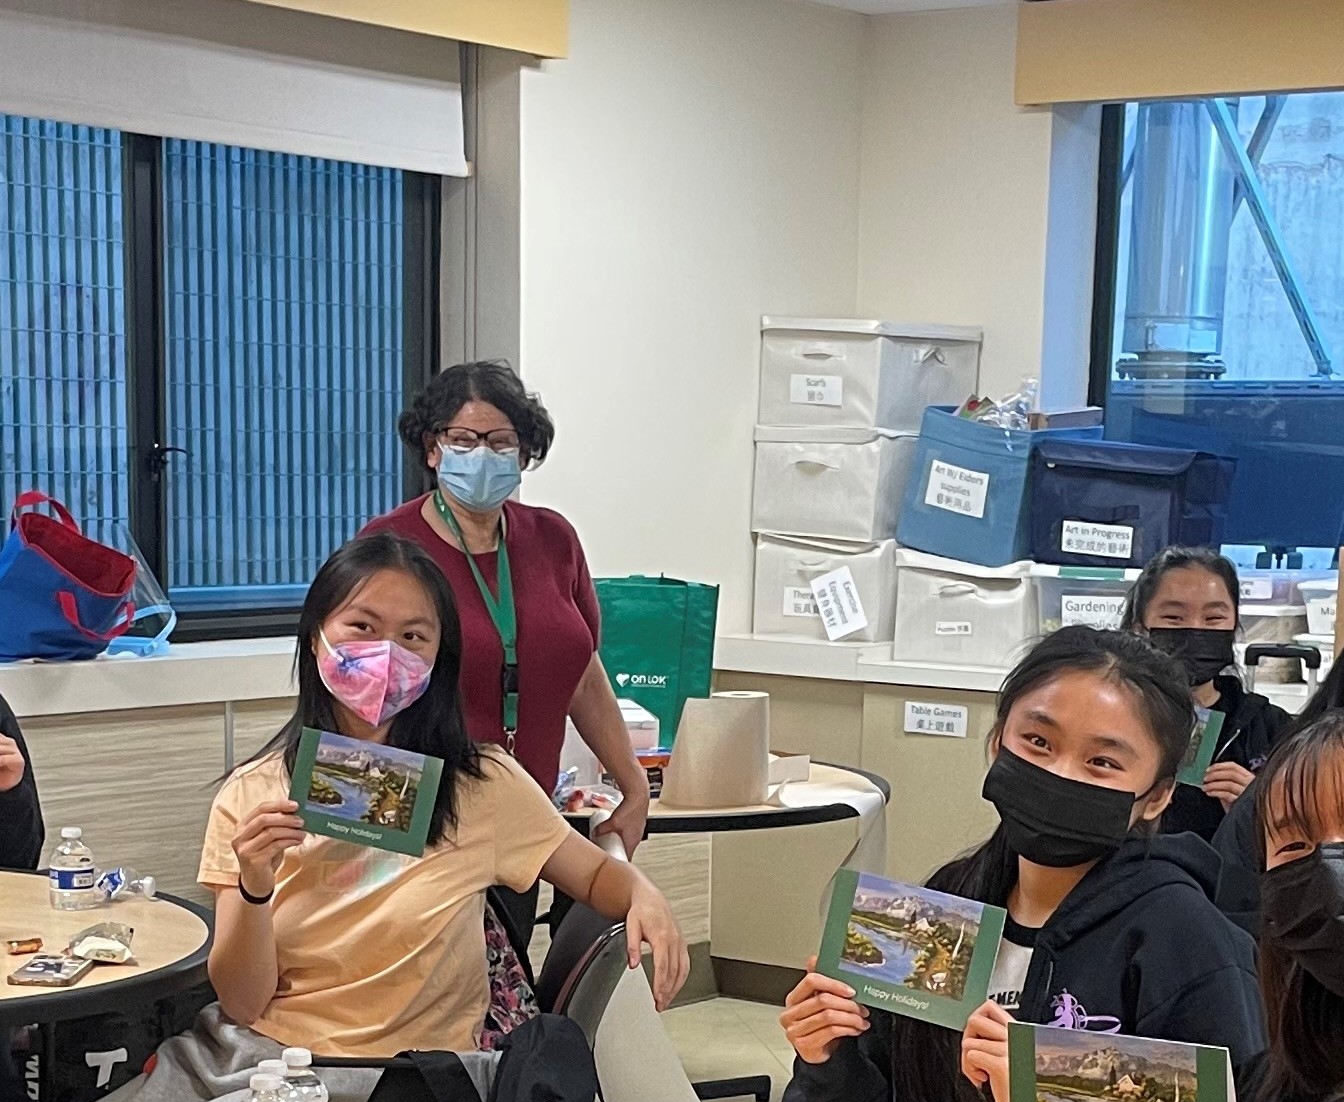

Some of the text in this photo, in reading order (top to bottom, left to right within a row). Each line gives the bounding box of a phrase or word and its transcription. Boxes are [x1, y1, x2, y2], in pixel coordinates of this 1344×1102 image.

[1066, 524, 1130, 540] Art in Progress
[1065, 600, 1125, 616] Gardening
[911, 705, 962, 718] Table Games
[863, 984, 930, 1010] Happy Holidays!
